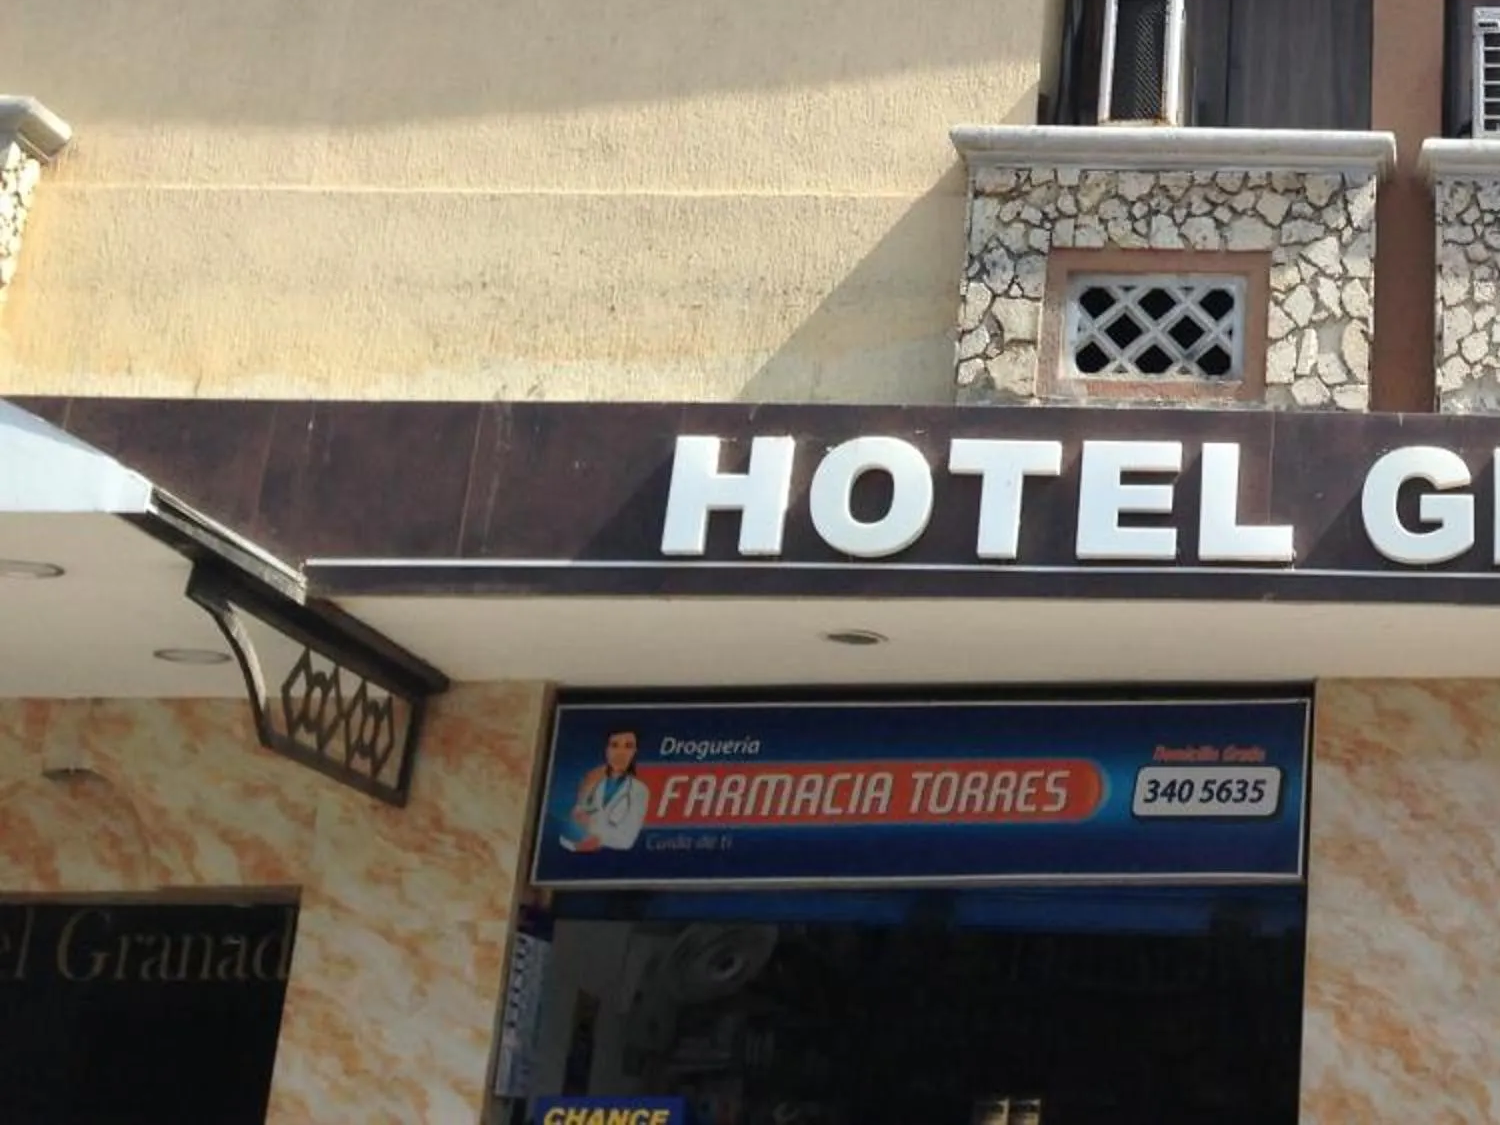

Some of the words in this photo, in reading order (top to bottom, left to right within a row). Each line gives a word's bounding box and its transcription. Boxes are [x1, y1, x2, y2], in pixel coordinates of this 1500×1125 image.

[660, 435, 1295, 561] HOTEL
[656, 771, 895, 818] FARMACIA
[909, 769, 1071, 814] TORRES
[1143, 778, 1195, 804] 340
[1199, 778, 1267, 804] 5635
